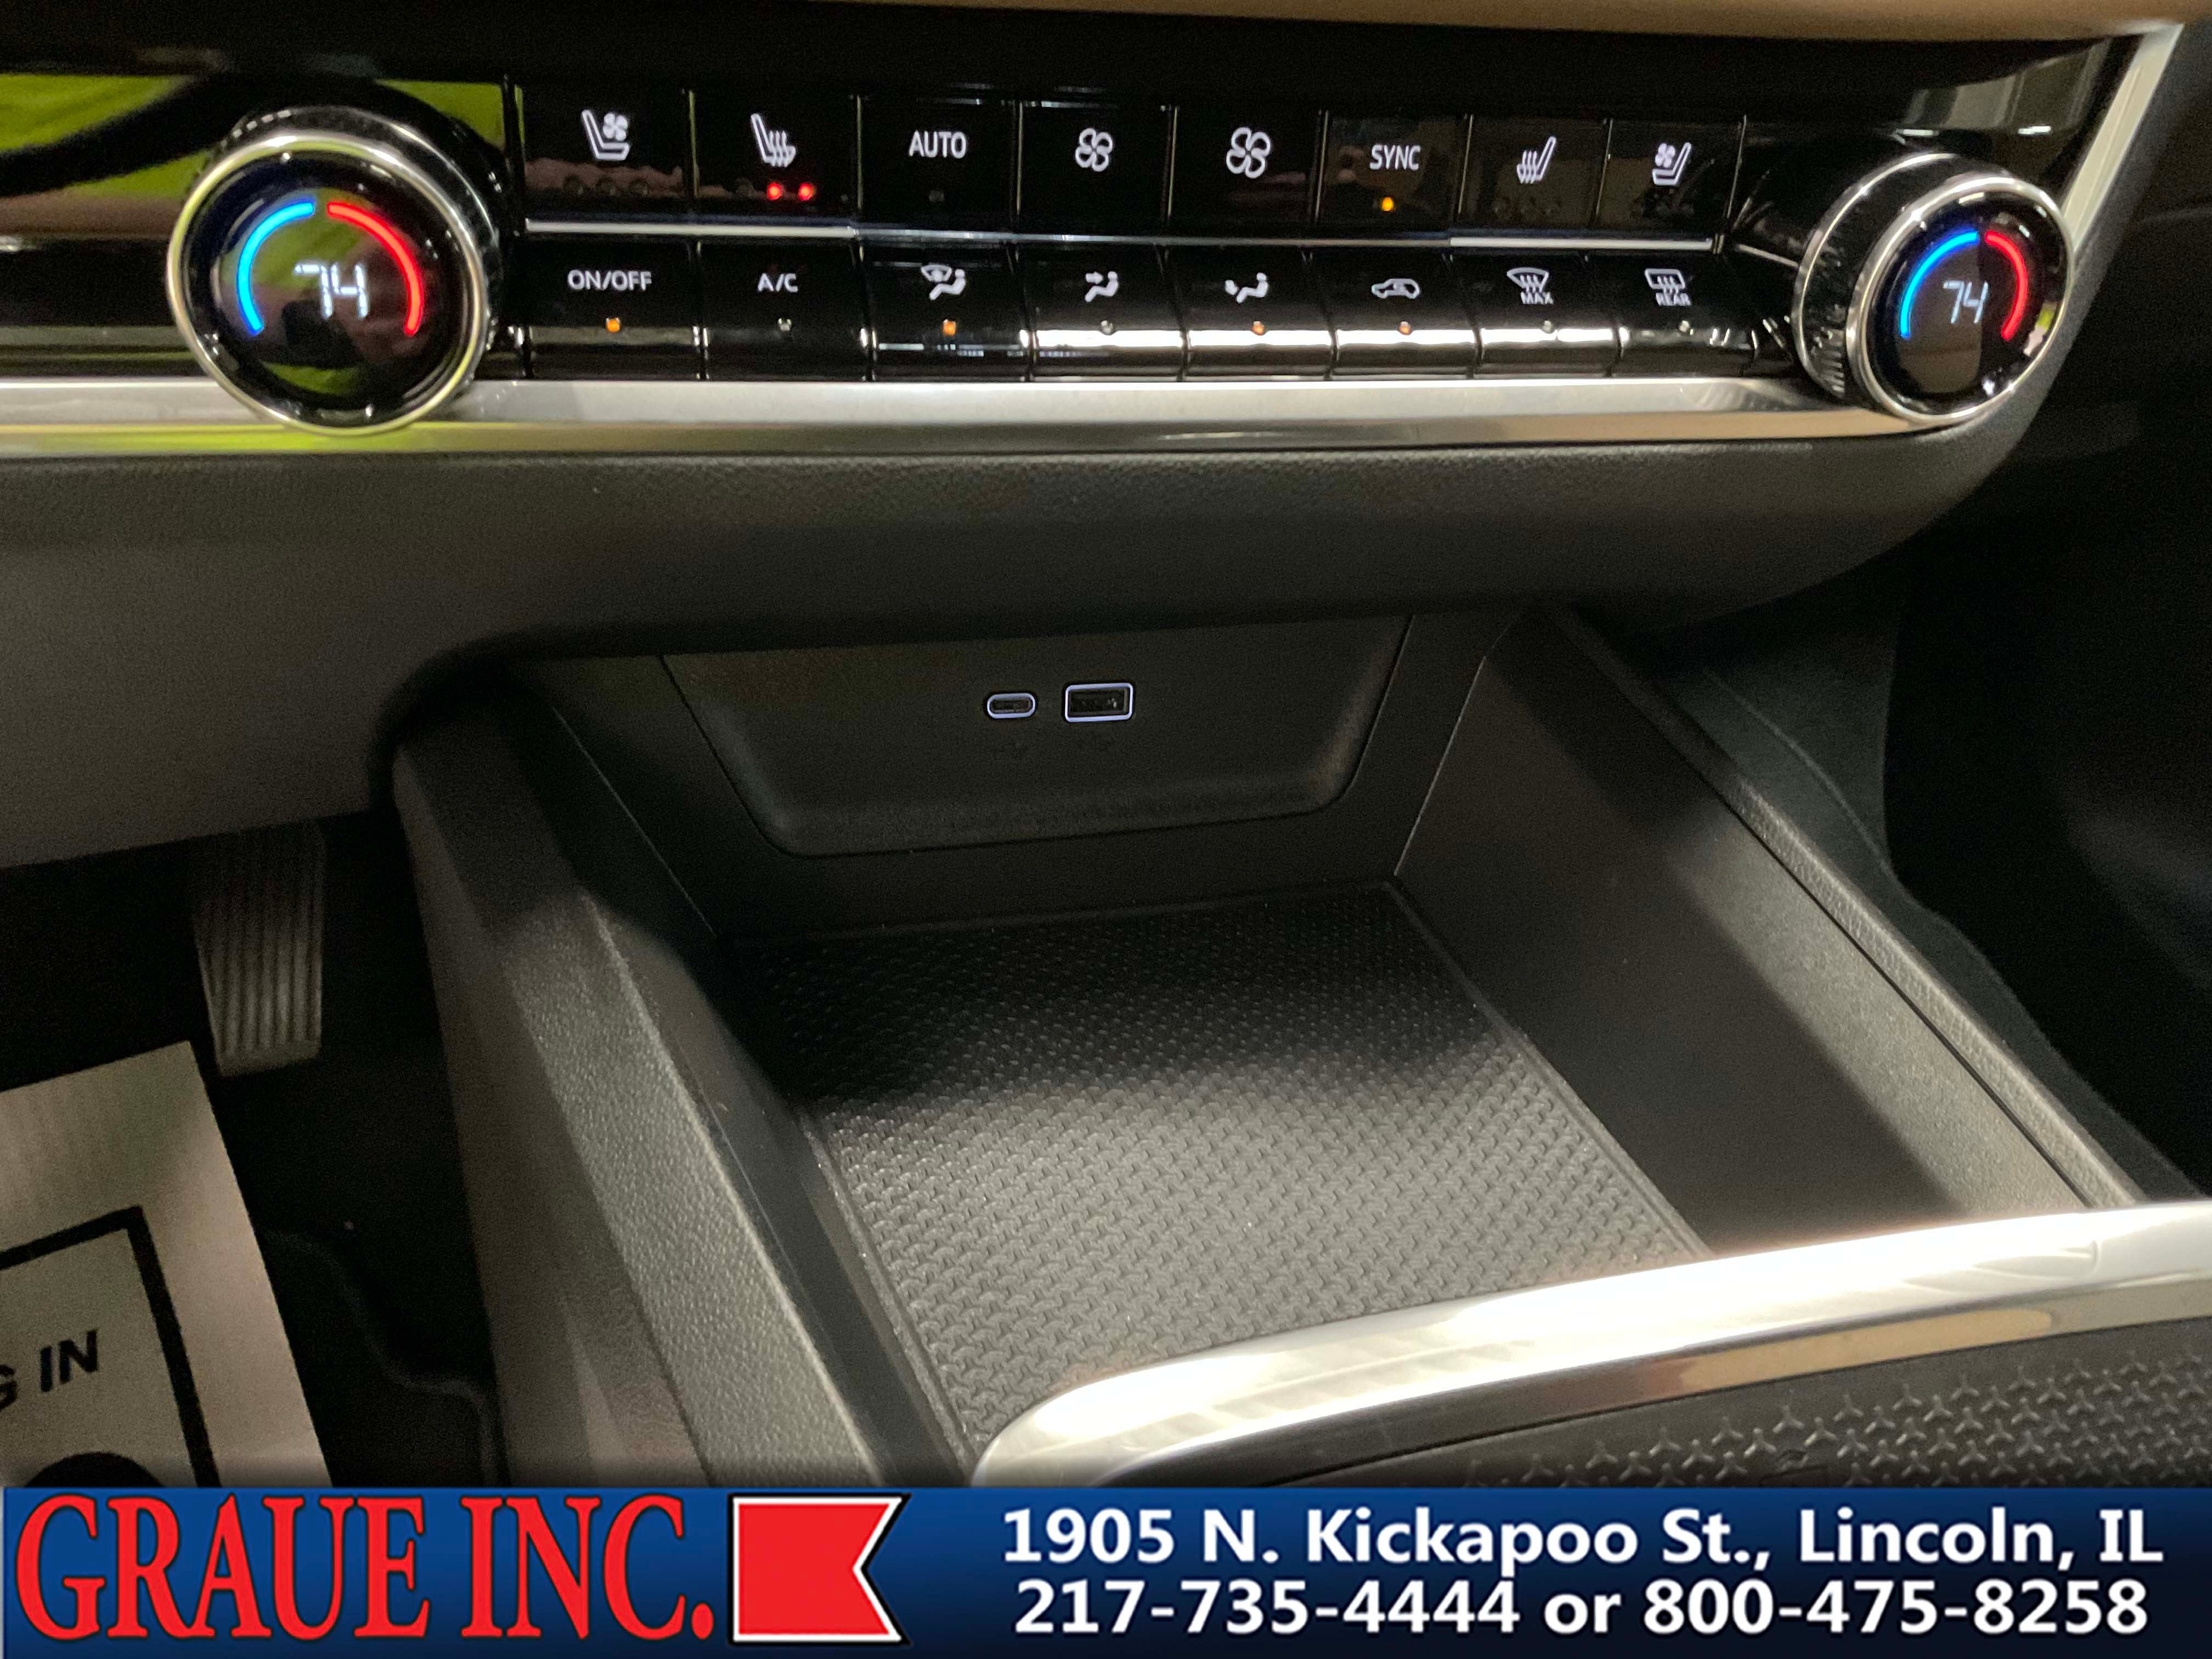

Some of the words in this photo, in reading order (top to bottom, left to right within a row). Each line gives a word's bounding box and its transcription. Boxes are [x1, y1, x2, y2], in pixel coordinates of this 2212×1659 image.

[909, 130, 967, 159] AUTO
[1369, 144, 1421, 171] SYNC
[293, 261, 369, 319] 74
[567, 269, 652, 291] ON/OFF
[757, 273, 799, 293] A/C
[1520, 292, 1554, 305] MAX
[1942, 279, 1989, 325] 74
[39, 1329, 98, 1392] IN
